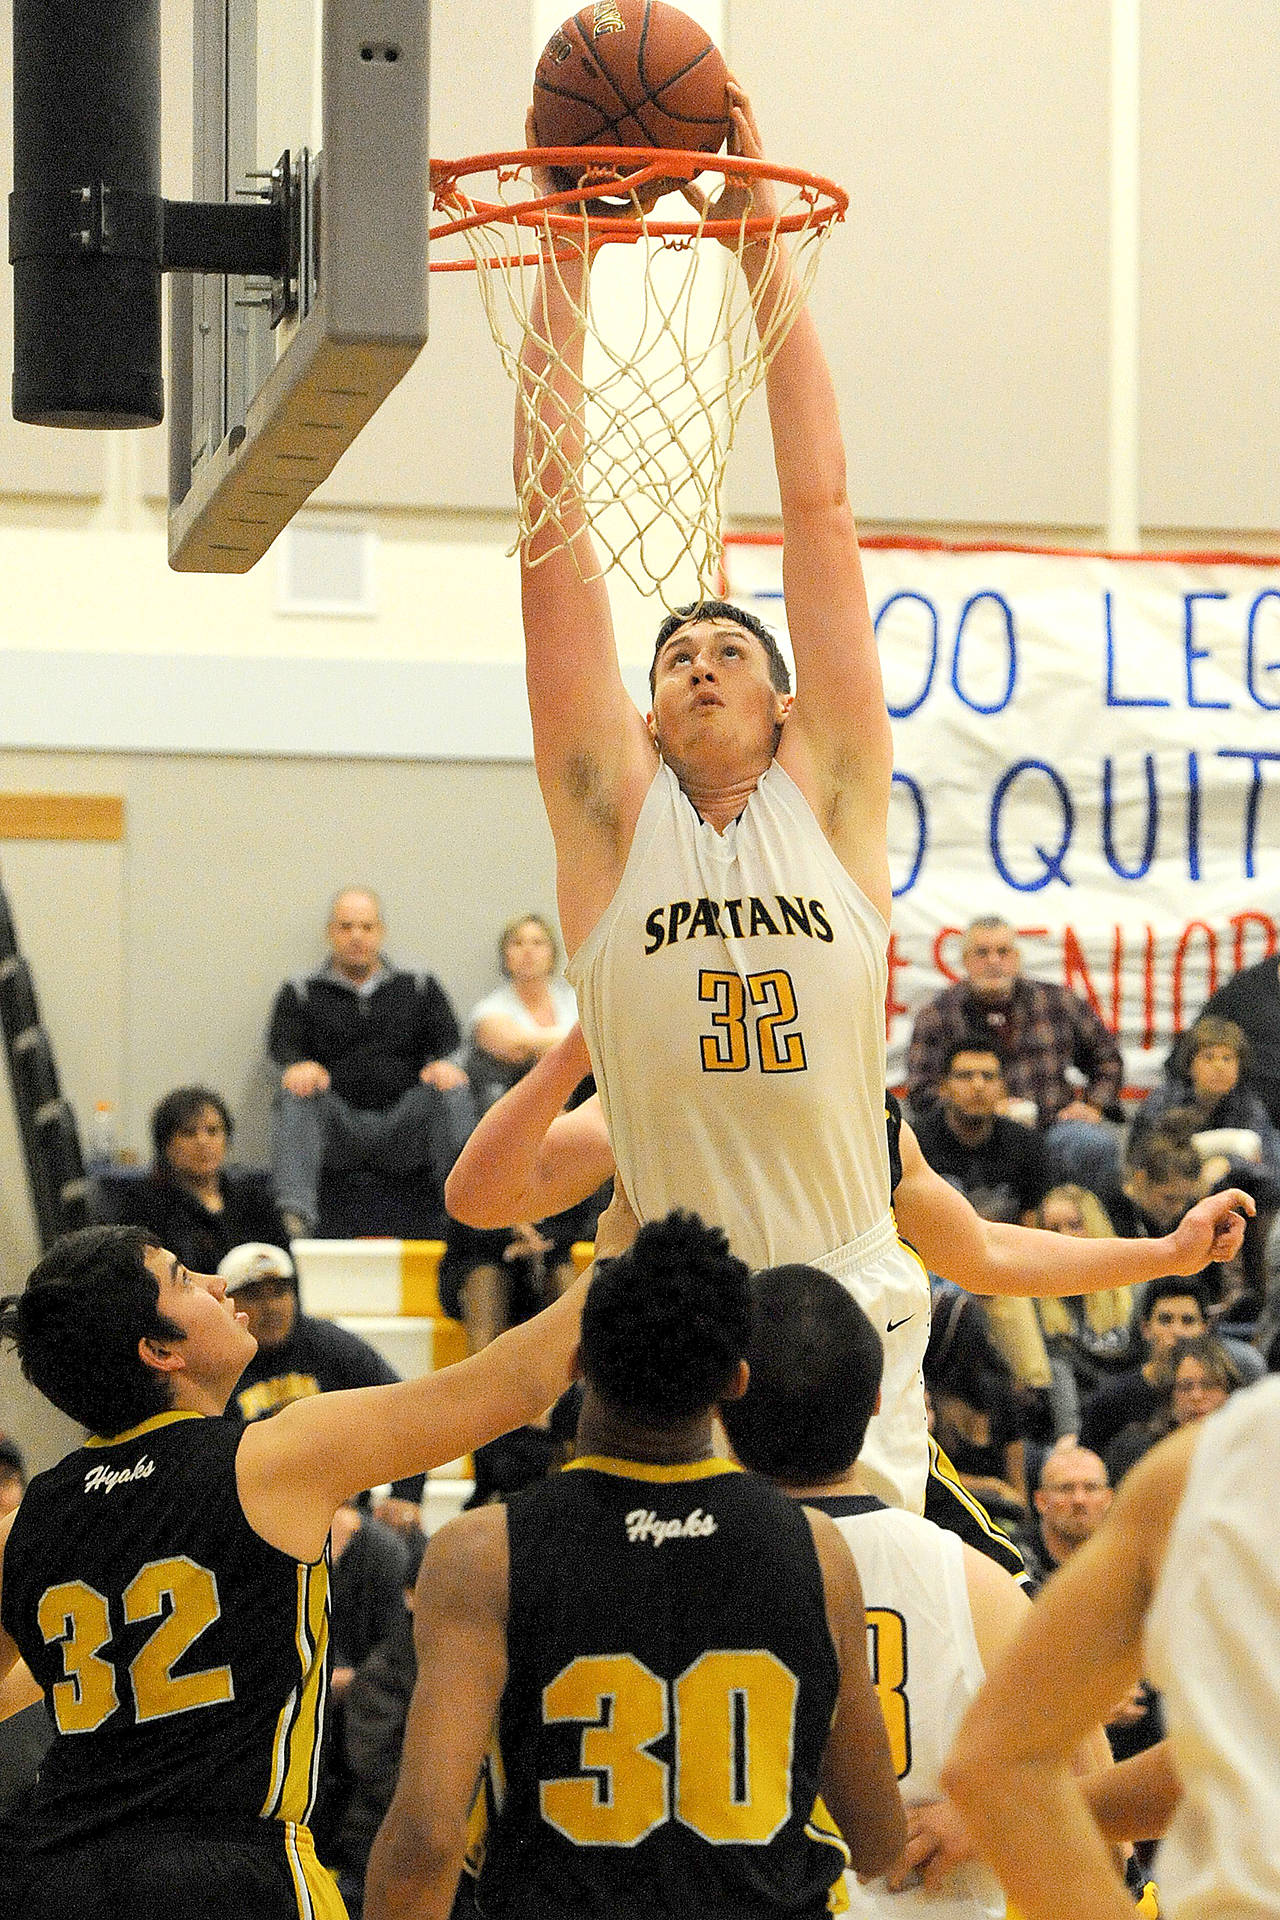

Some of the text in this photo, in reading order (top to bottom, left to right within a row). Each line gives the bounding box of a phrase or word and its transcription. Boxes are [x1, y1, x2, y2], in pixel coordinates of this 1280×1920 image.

[753, 589, 1017, 718] OO
[988, 749, 1280, 893] QUIT
[644, 895, 835, 956] SPARTANS
[698, 968, 808, 1074] 32
[83, 1453, 157, 1495] Hyaks
[624, 1507, 719, 1549] Hyaks
[36, 1555, 236, 1736] 32
[539, 1648, 800, 1848] 30
